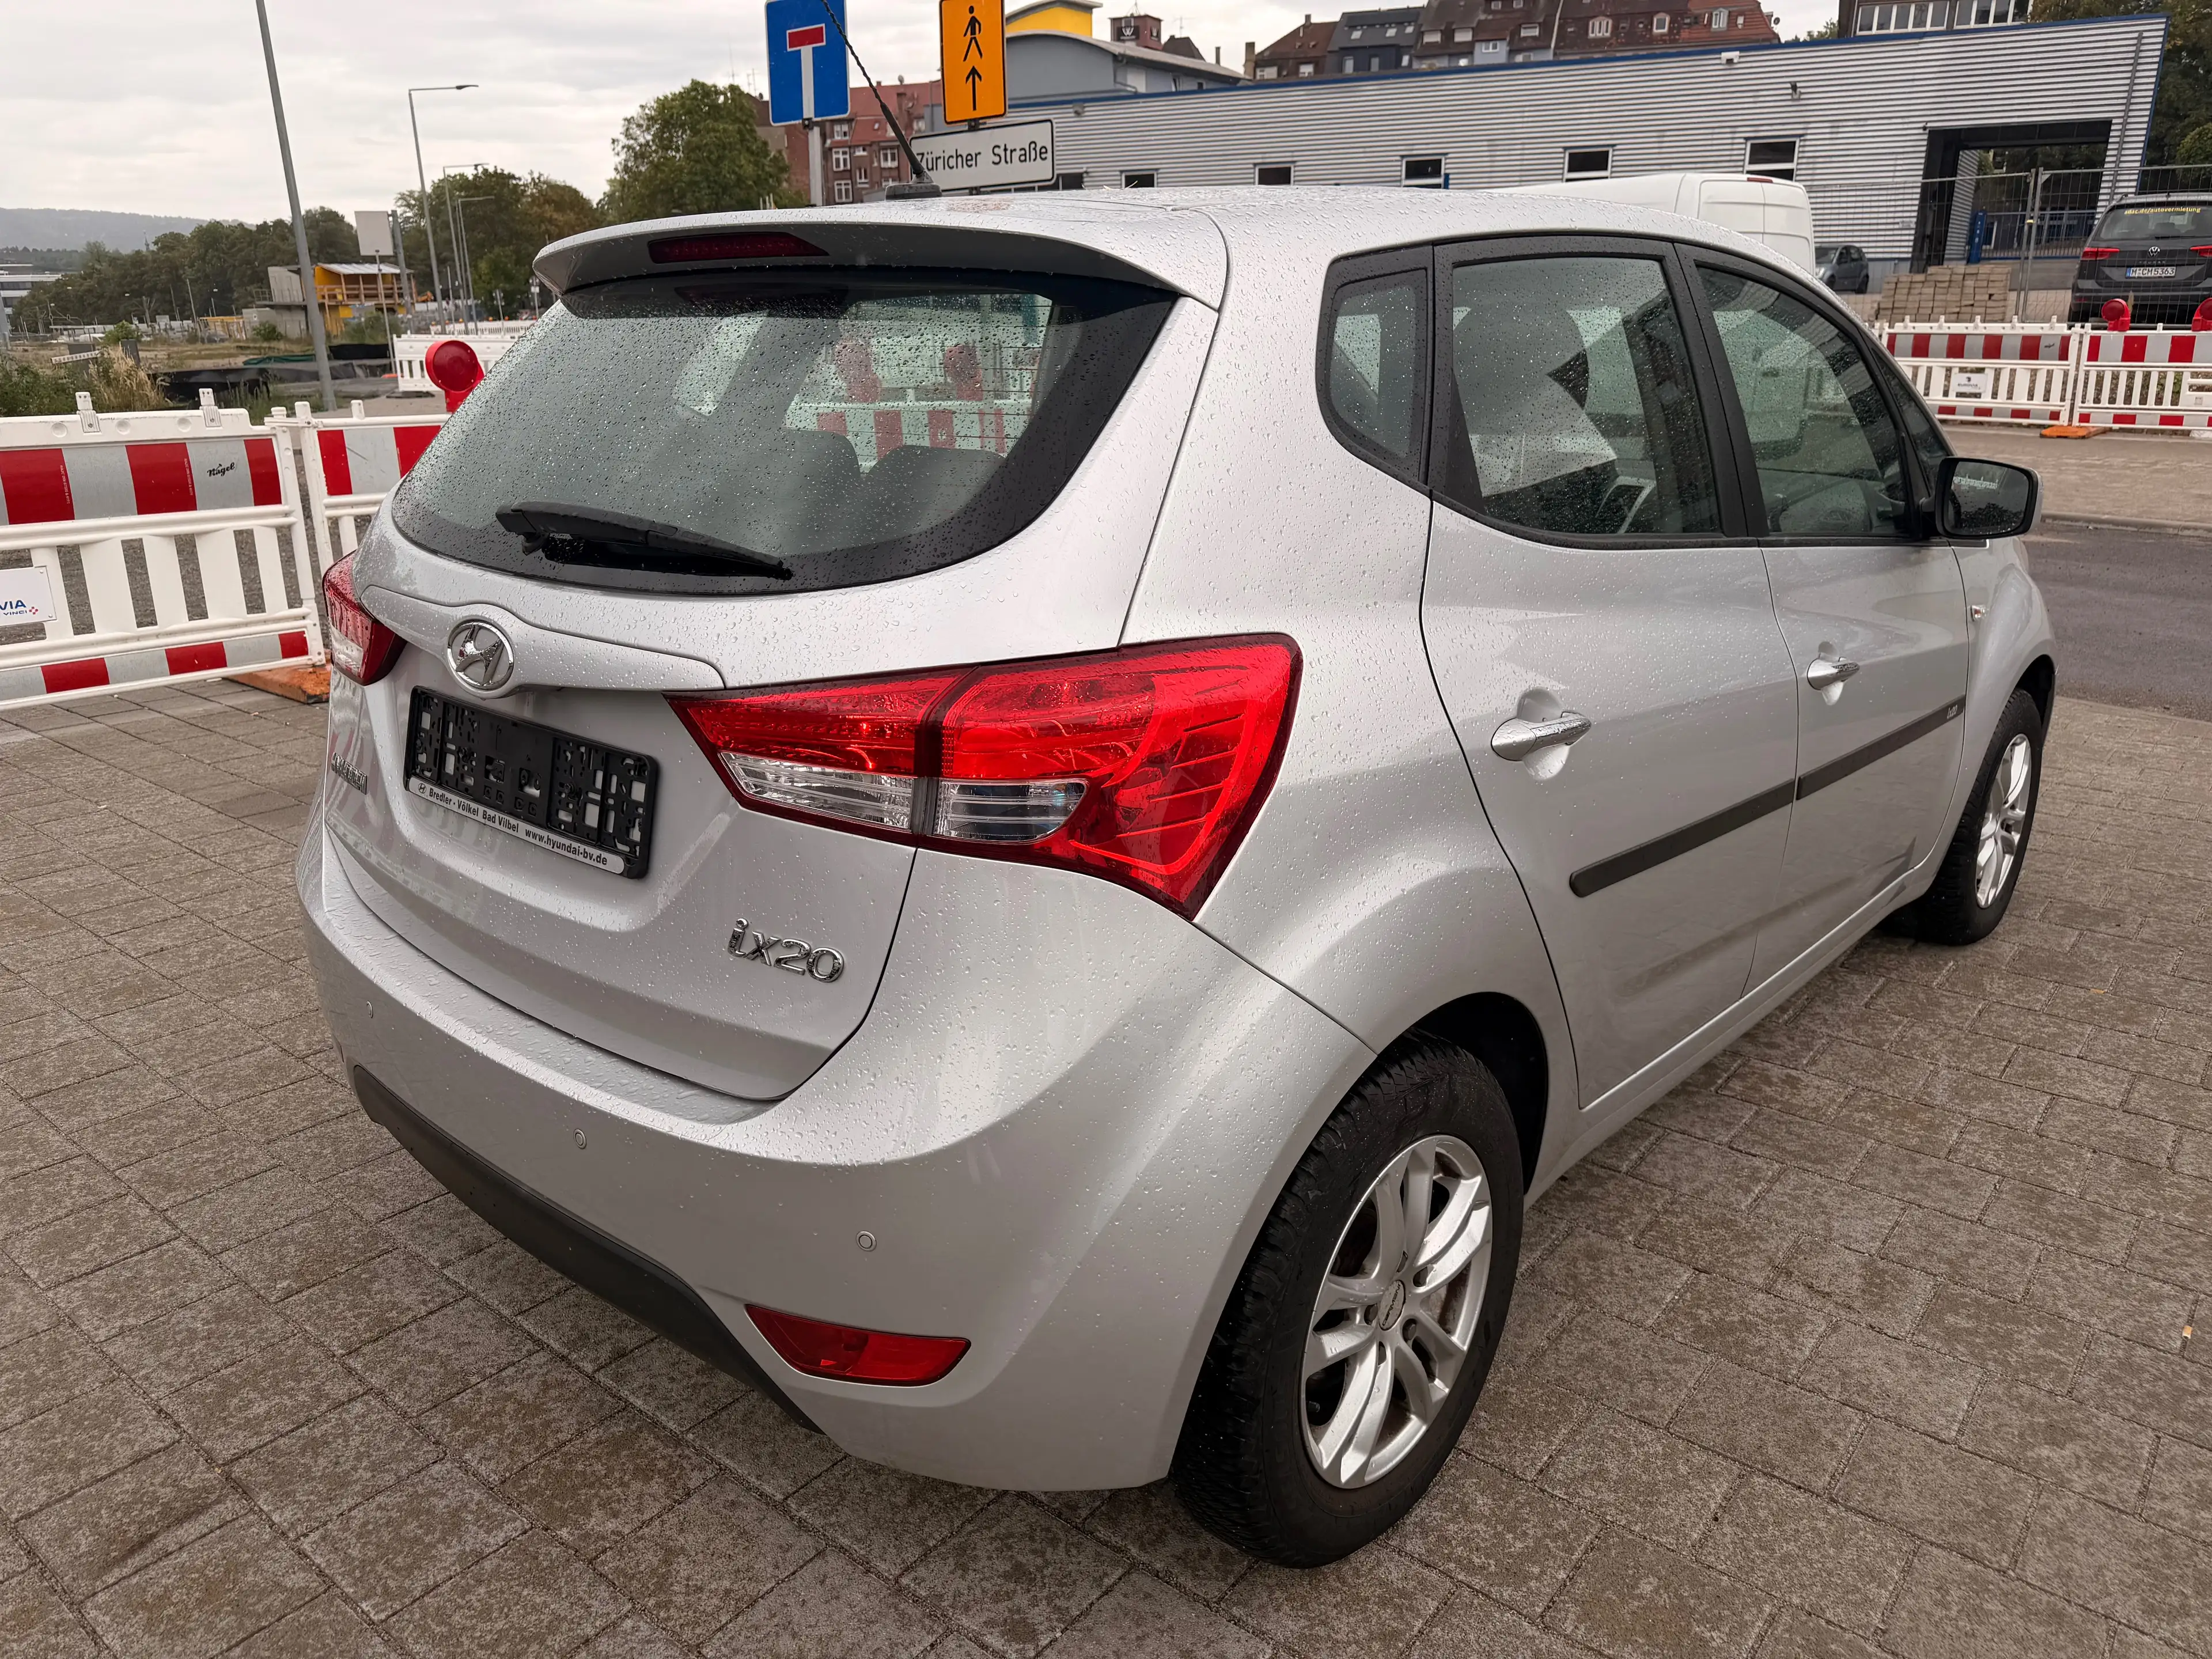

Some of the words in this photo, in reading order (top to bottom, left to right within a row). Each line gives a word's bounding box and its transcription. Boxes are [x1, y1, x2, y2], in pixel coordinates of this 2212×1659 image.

[991, 141, 1047, 165] Straße
[429, 787, 452, 805] Bredler
[458, 799, 479, 817] Völkel
[483, 810, 496, 824] Bad
[498, 815, 519, 833] Vilbel
[525, 828, 607, 866] www.hyundai-bv.de
[728, 917, 844, 983] ix20
